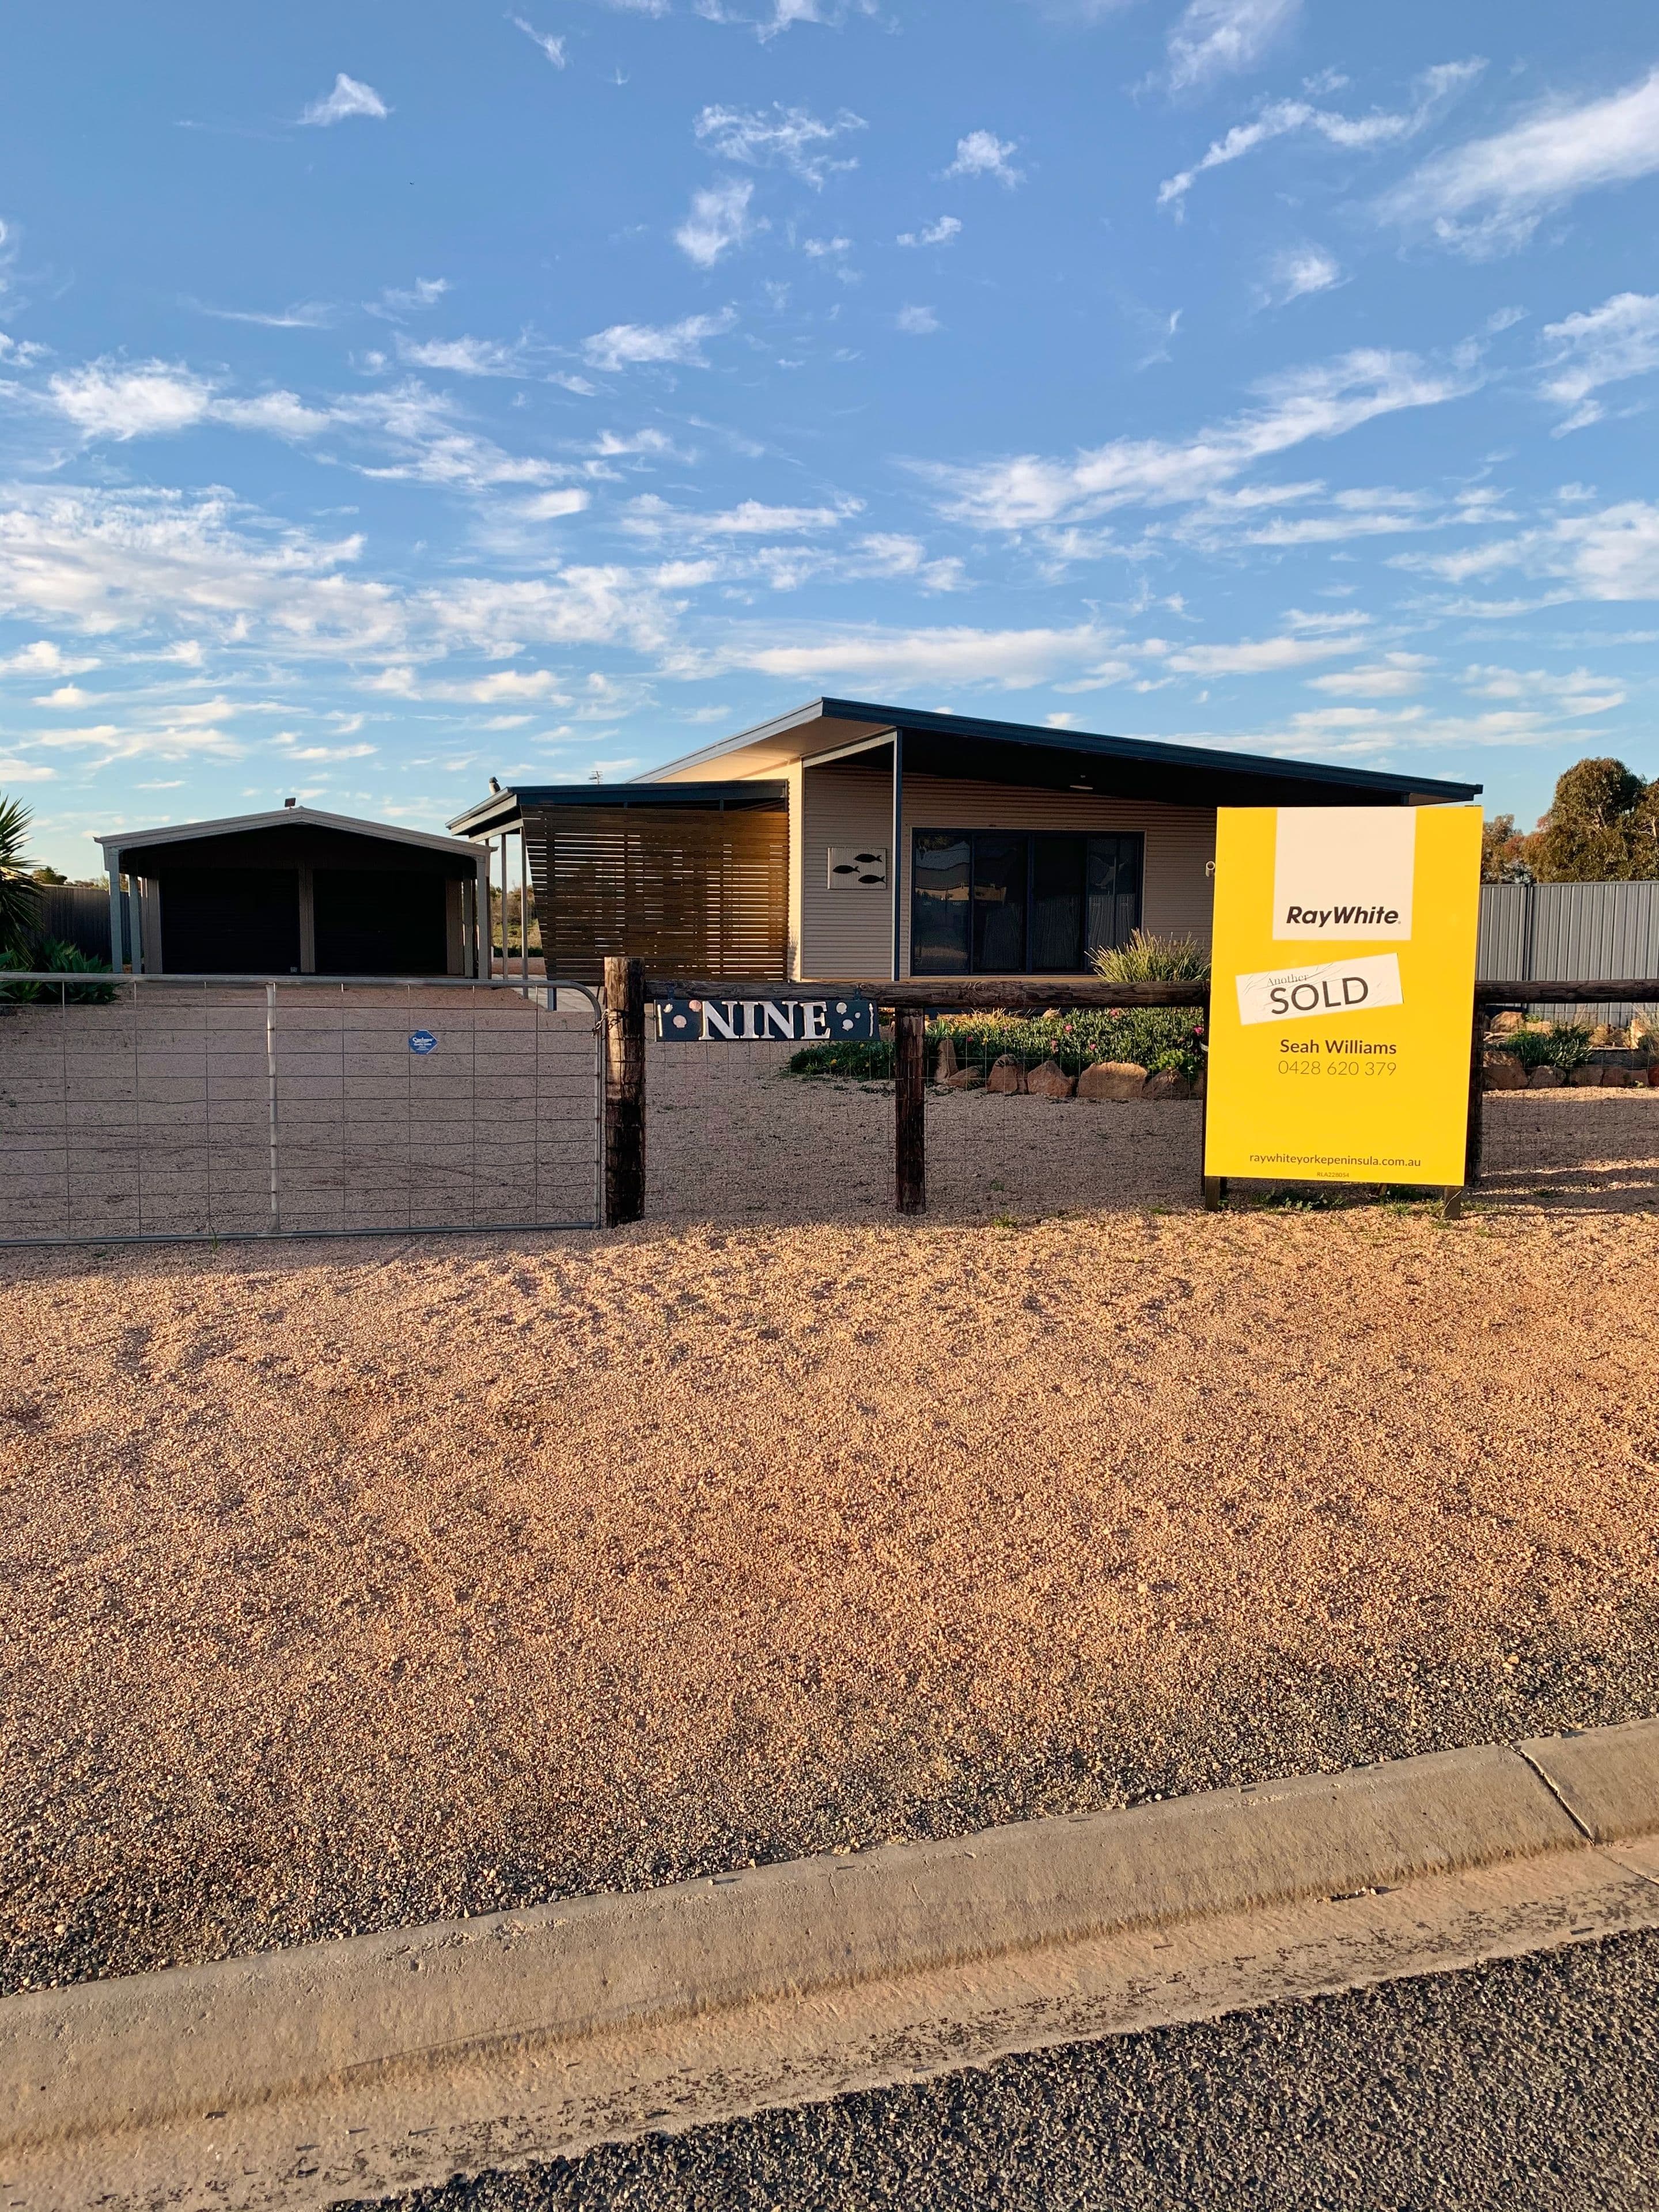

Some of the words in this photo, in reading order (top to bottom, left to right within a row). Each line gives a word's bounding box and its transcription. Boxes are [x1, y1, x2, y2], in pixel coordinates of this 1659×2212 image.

[1267, 974, 1309, 987] Another
[1270, 976, 1369, 1014] SOLD
[698, 1001, 831, 1040] NINE
[1279, 1039, 1319, 1054] Seah
[1324, 1040, 1397, 1055] Williams
[1278, 1060, 1321, 1075] 0428
[1327, 1061, 1359, 1075] 620
[1365, 1062, 1397, 1076] 379
[1249, 1153, 1422, 1166] raywhiteyorkepeninsula.com.au
